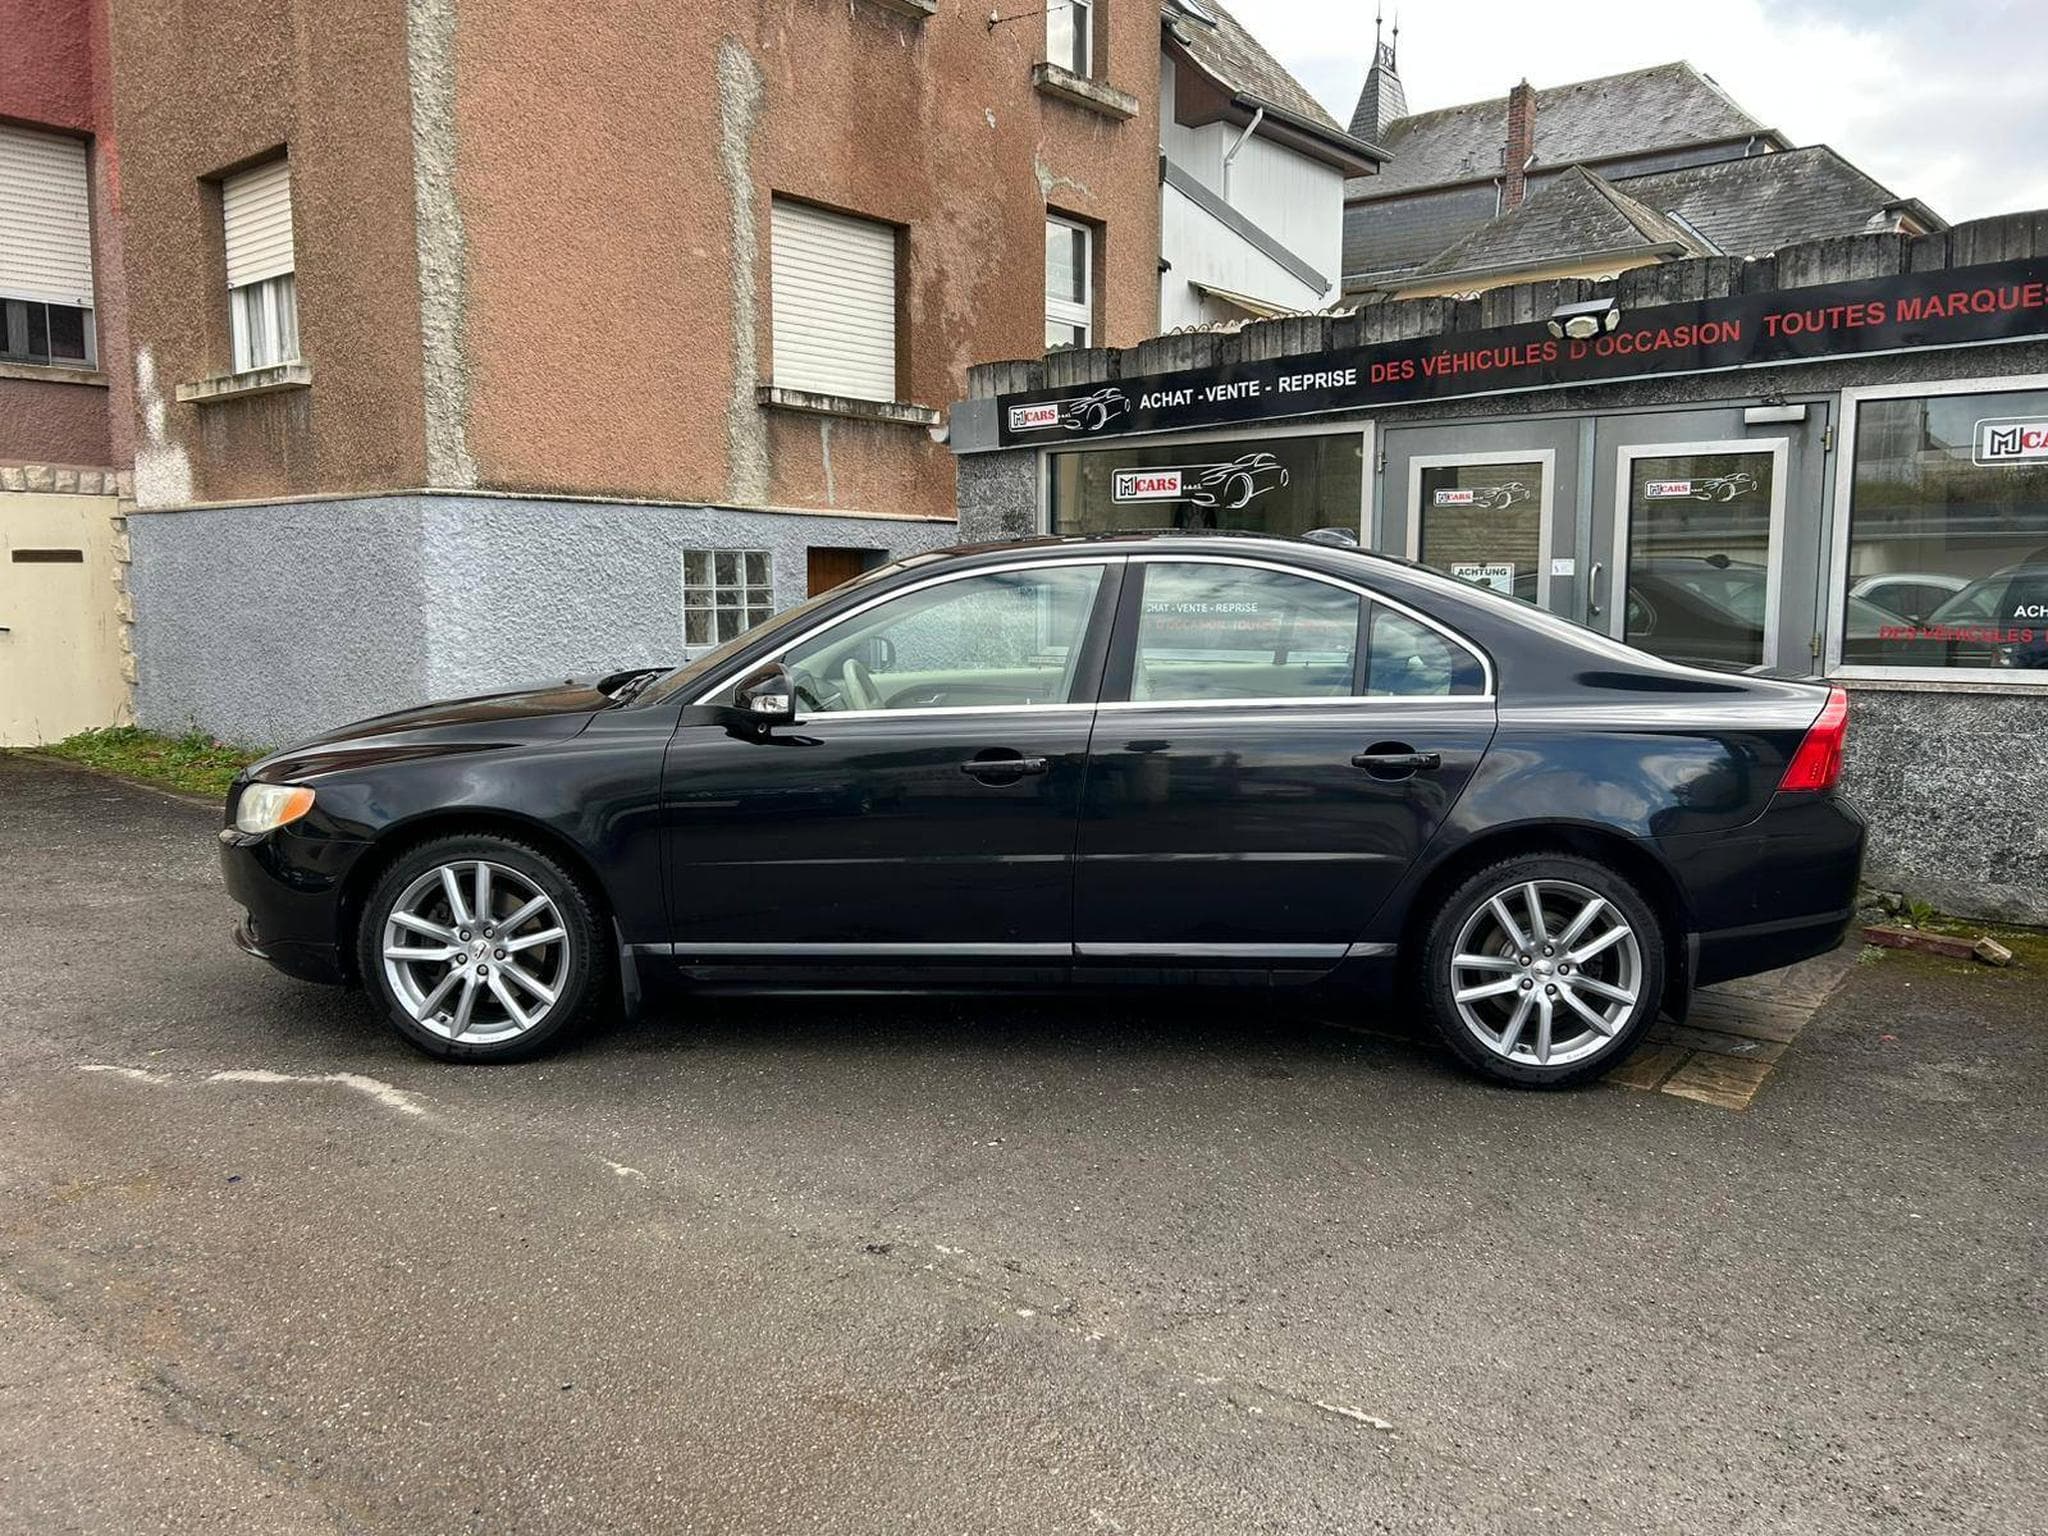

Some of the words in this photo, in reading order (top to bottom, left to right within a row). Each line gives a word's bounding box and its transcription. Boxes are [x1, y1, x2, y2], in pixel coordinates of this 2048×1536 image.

[1139, 388, 1194, 410] ACHAT
[1205, 380, 1260, 403] VENTE
[1278, 368, 1357, 393] REPRISE
[1370, 360, 1416, 384] DES
[1421, 341, 1558, 377] VÉHICULES
[1763, 302, 1886, 338] TOUTES
[1896, 283, 2048, 322] MARQUE
[1457, 567, 1508, 577] ACHTUNG
[1176, 602, 1208, 613] VENTE
[1215, 602, 1259, 613] REPRISE
